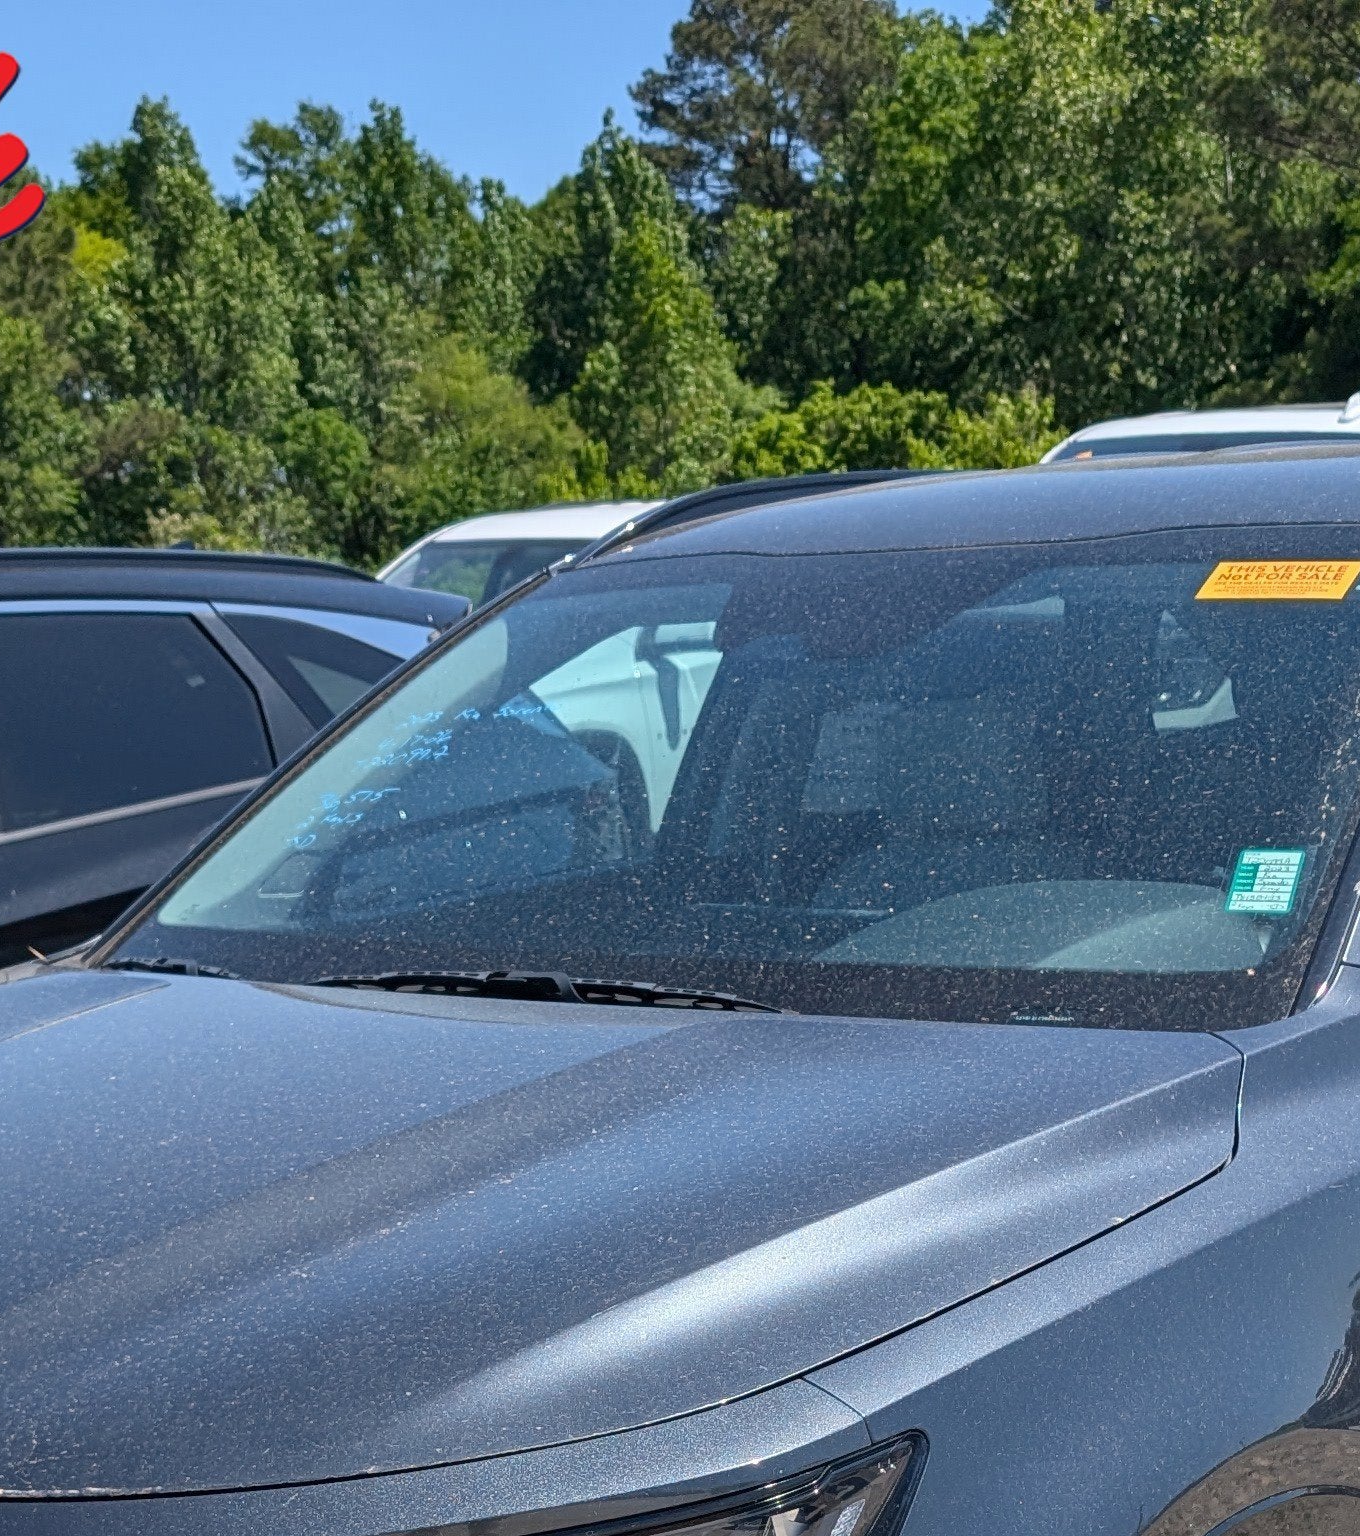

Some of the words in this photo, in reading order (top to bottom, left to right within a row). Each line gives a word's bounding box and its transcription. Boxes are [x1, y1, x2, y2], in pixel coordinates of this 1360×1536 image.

[1226, 564, 1267, 573] THIS
[1272, 564, 1349, 573] VEHICLE
[1217, 572, 1252, 581] Not
[1254, 572, 1293, 581] FOR
[1296, 572, 1344, 581] SALE
